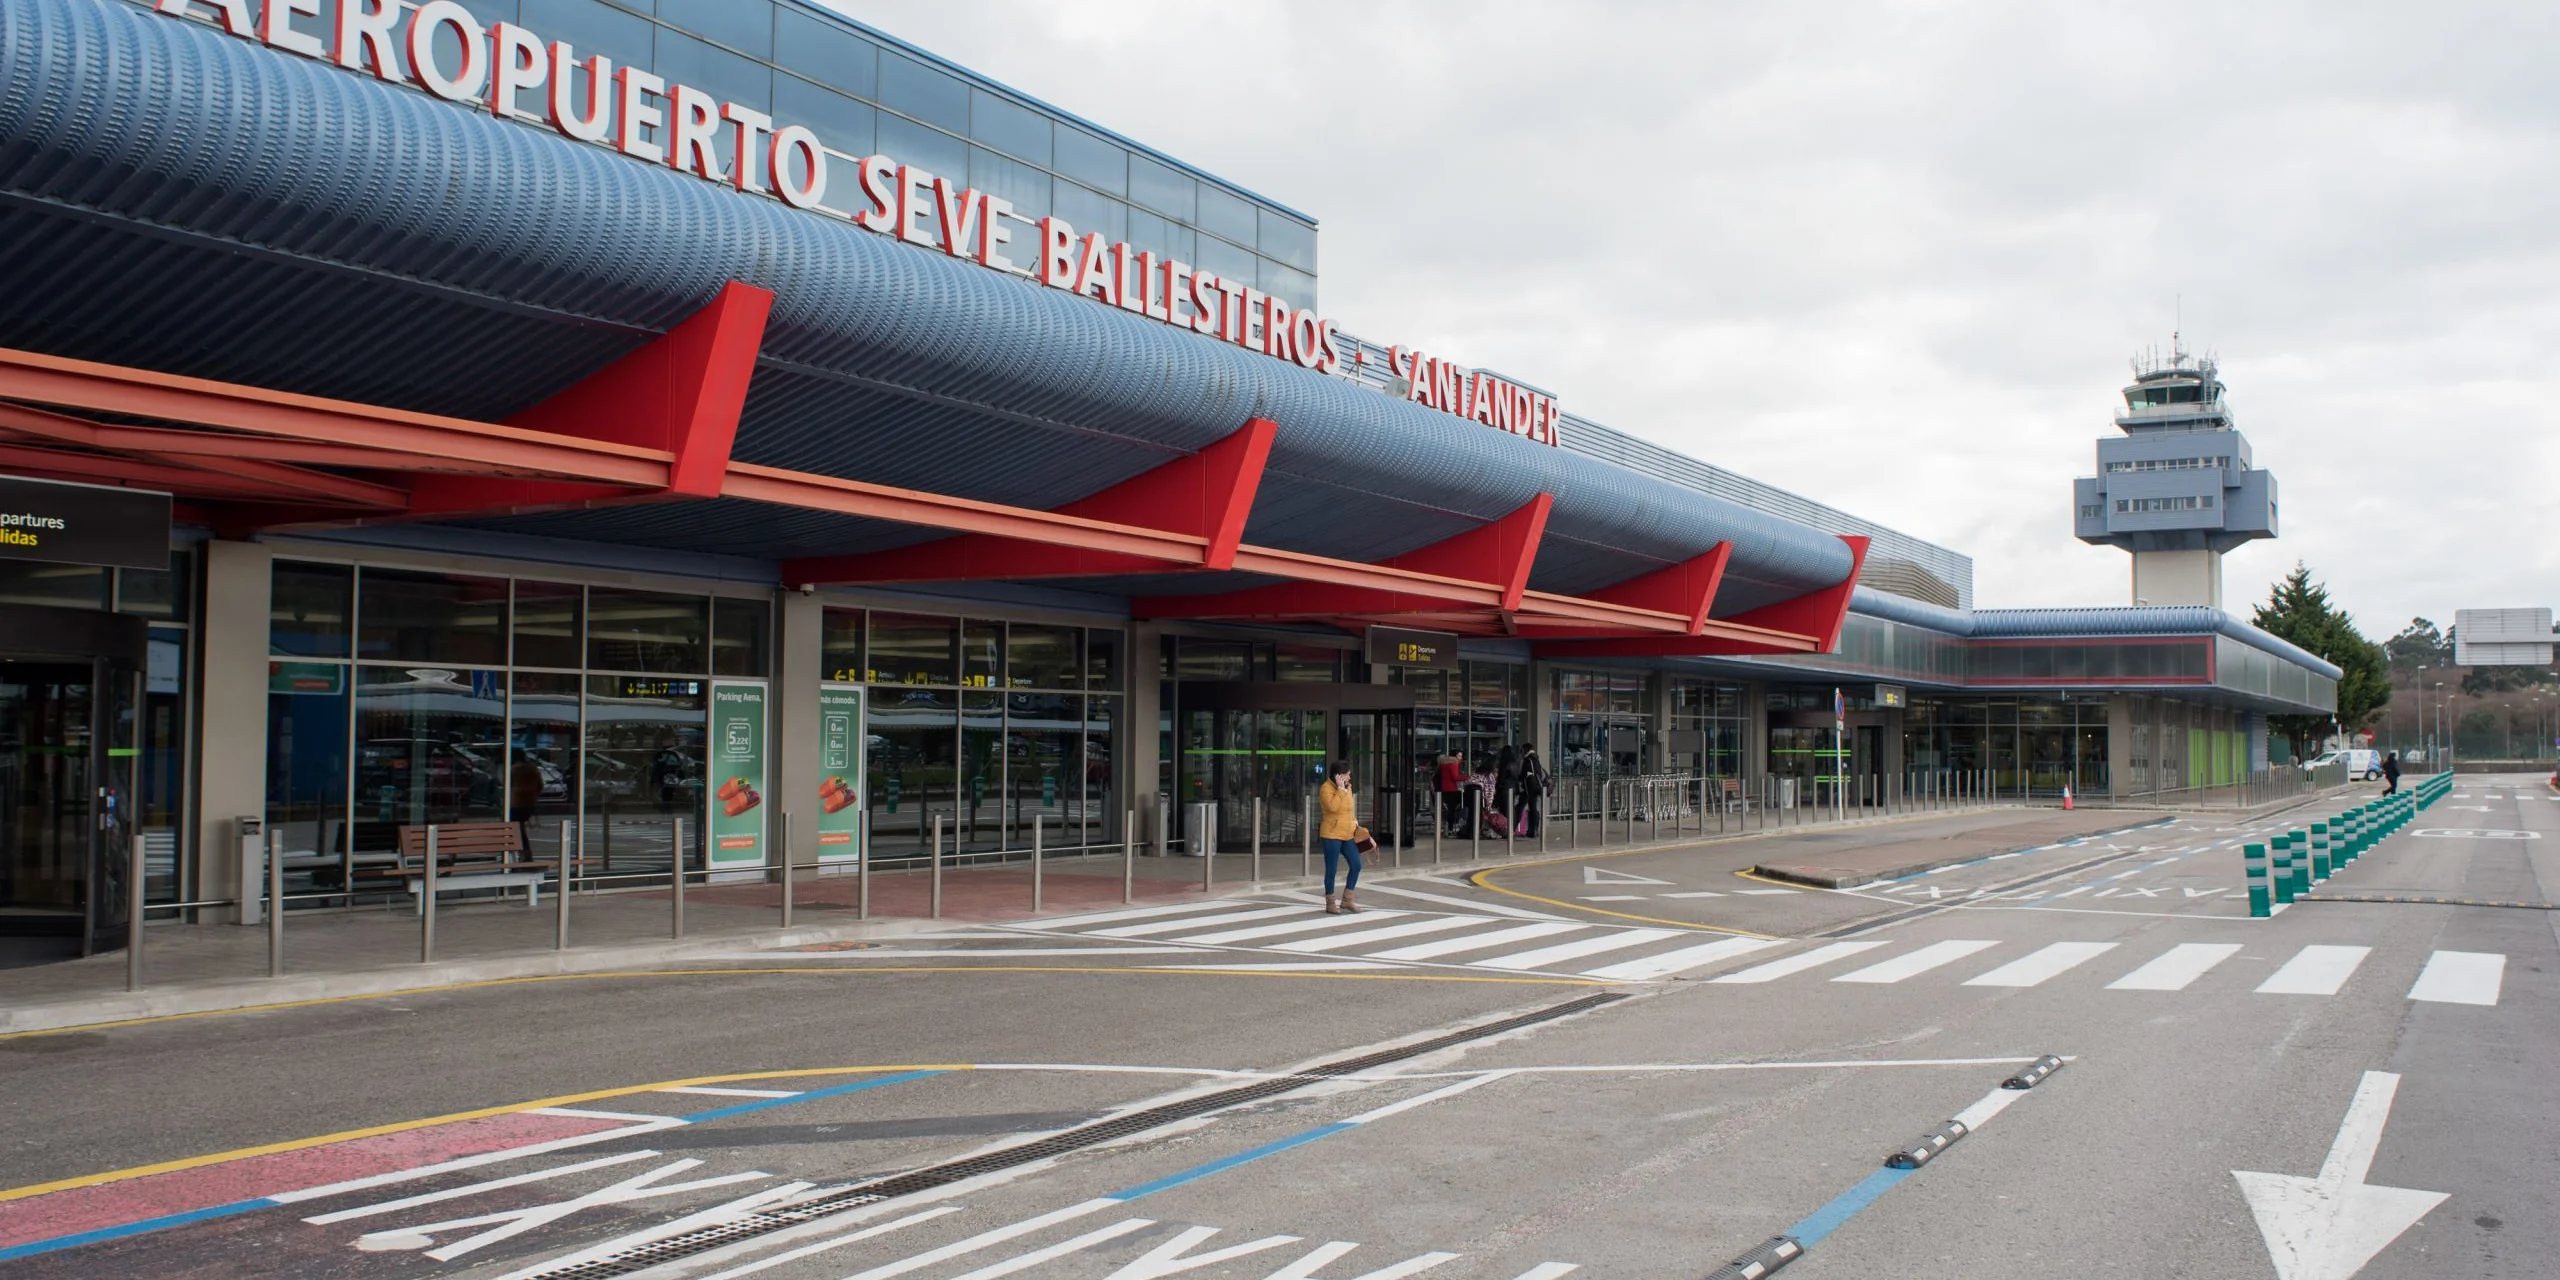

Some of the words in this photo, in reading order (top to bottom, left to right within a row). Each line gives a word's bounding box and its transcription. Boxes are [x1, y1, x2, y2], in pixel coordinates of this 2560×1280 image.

[857, 155, 1013, 273] SEVE
[1041, 215, 1340, 375] BALLESTEROS
[1389, 344, 1561, 449] SANTANDER
[717, 693, 742, 702] Parking
